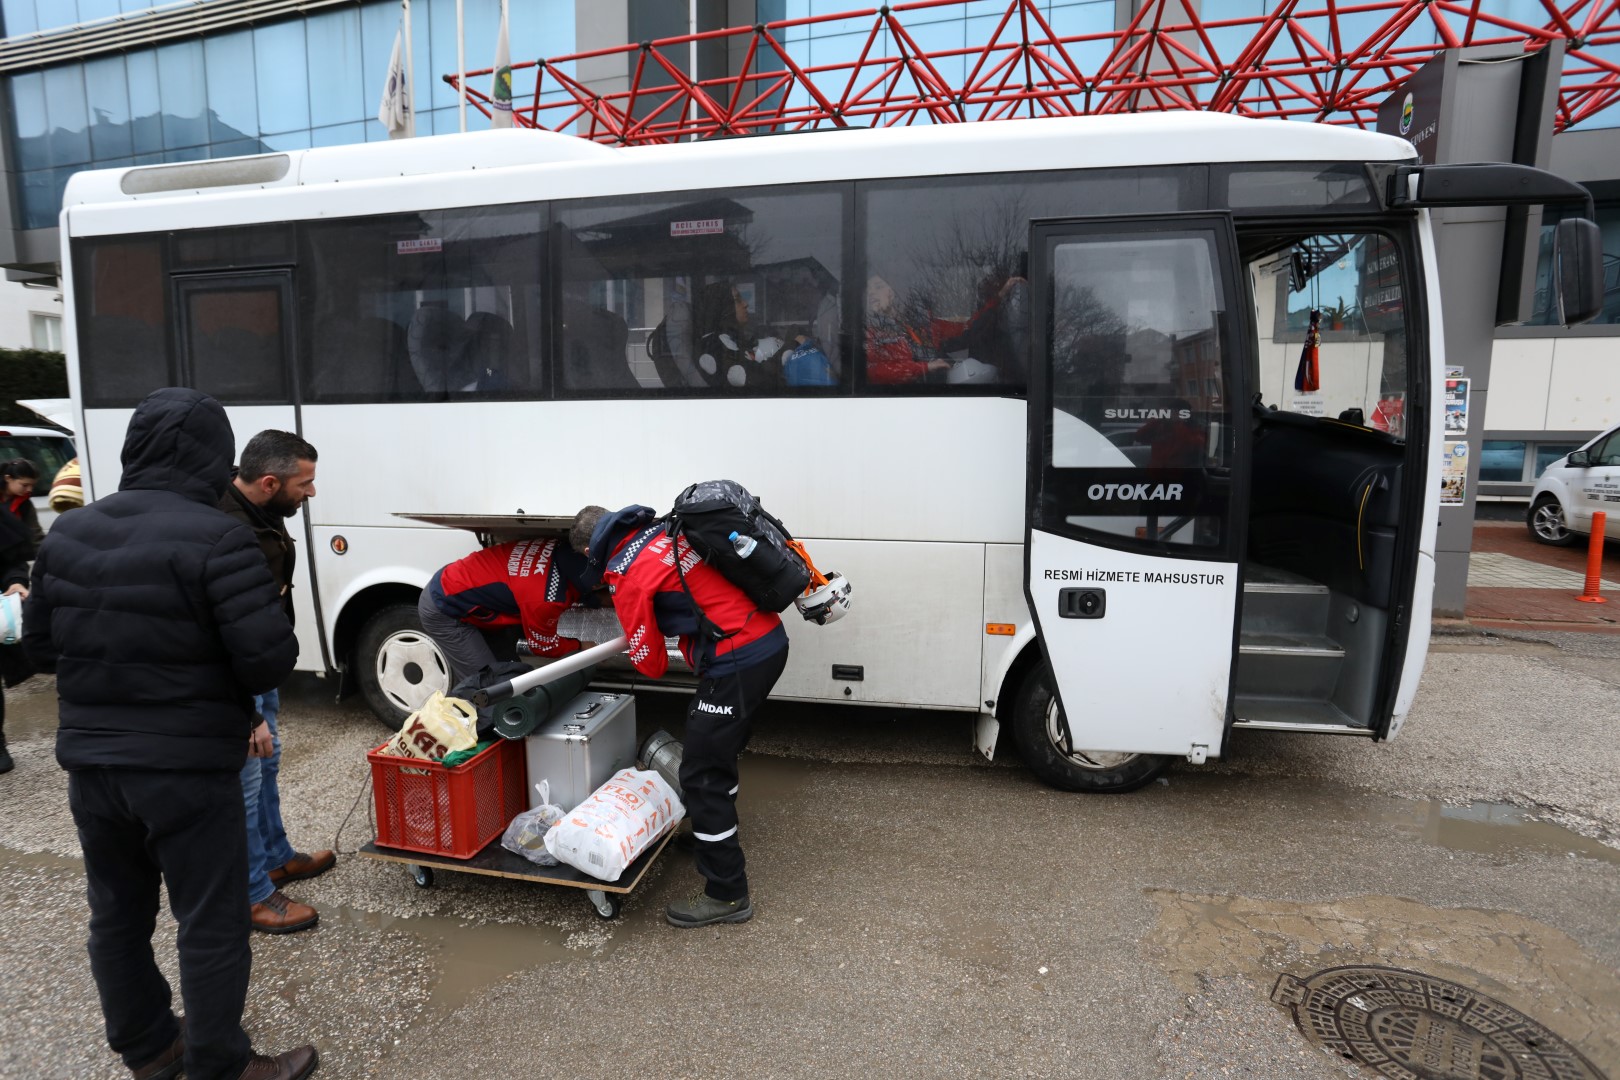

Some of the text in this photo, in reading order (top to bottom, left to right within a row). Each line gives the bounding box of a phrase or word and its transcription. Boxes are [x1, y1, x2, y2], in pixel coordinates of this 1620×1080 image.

[1104, 408, 1191, 419] SULTAN S
[1087, 483, 1184, 500] OTOKAR
[1044, 568, 1225, 585] RESMİ HİZMETE MAHSUSTUR
[603, 784, 639, 804] FLO
